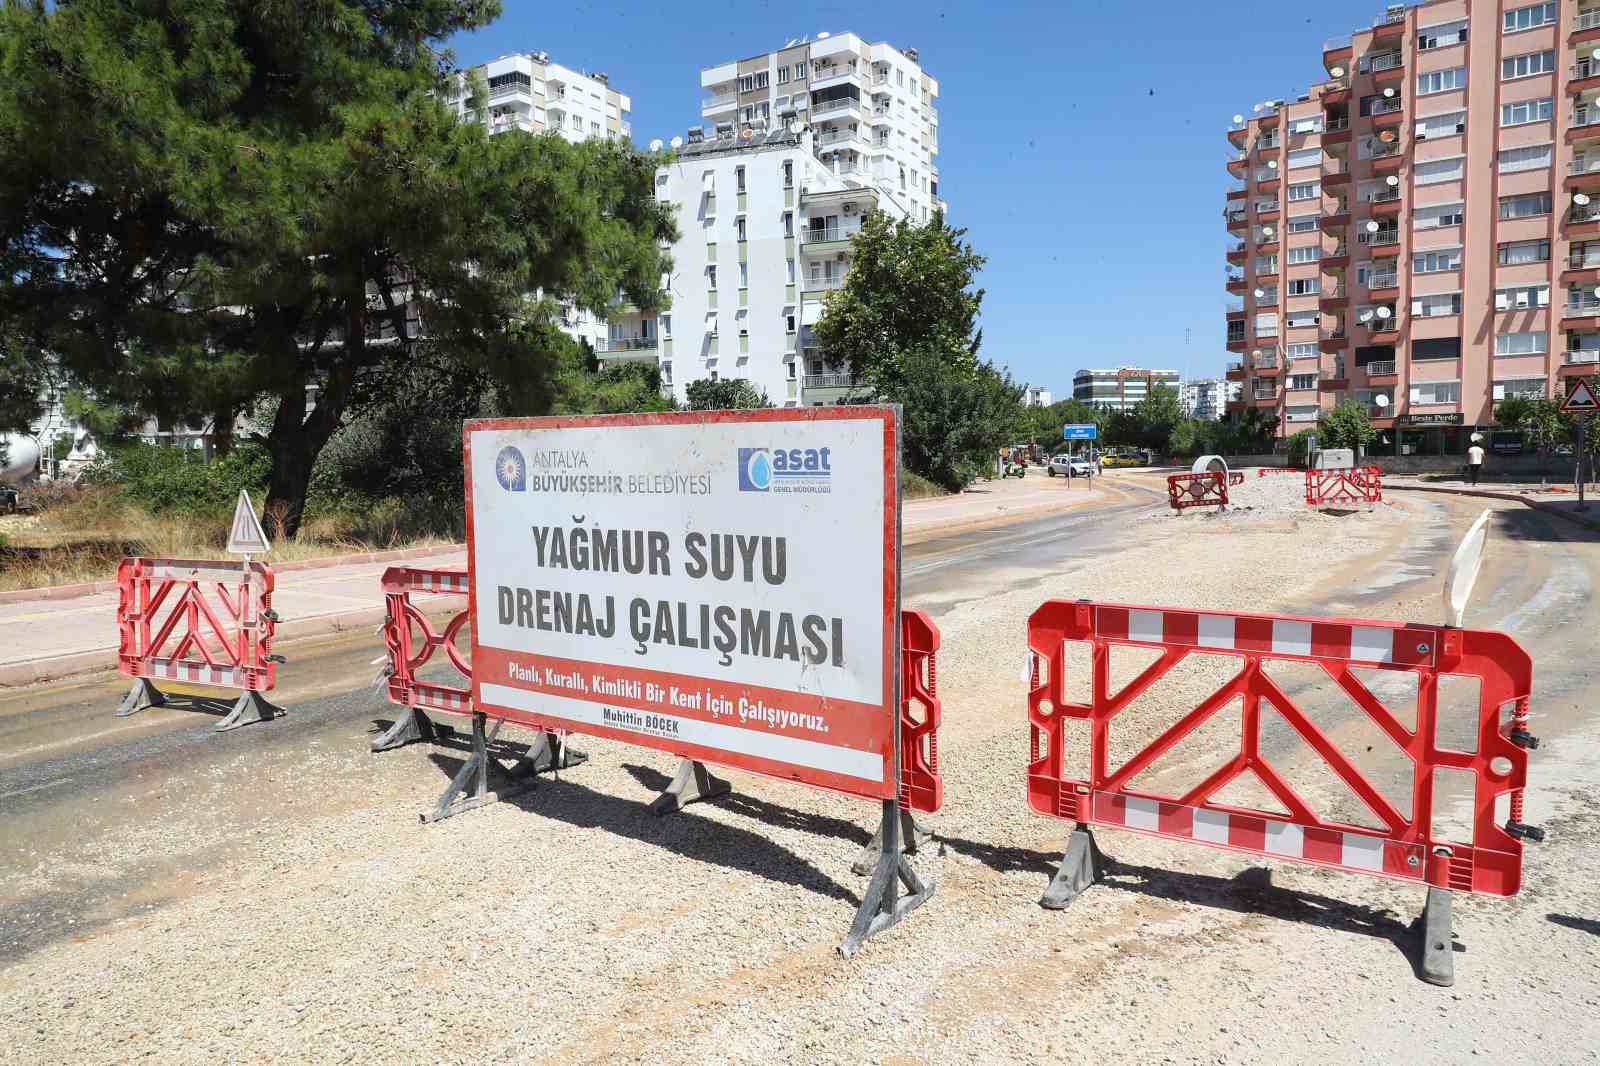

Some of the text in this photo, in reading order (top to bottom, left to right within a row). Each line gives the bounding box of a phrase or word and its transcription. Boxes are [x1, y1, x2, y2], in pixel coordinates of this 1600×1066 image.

[532, 450, 588, 469] ANTALYA
[773, 447, 831, 470] asat
[532, 471, 711, 496] BÜYÜKŞEHİR BELEDİYESİ
[532, 514, 787, 585] YAĞMUR SUYU
[497, 585, 844, 667] DRENAJ ÇALIŞMASI
[508, 662, 829, 732] Planlı, Kurallı, Kimlikli Bir Kent İçin Çalışıyoruz.
[603, 707, 642, 726] Muhittin
[645, 714, 679, 734] BÖCEK
